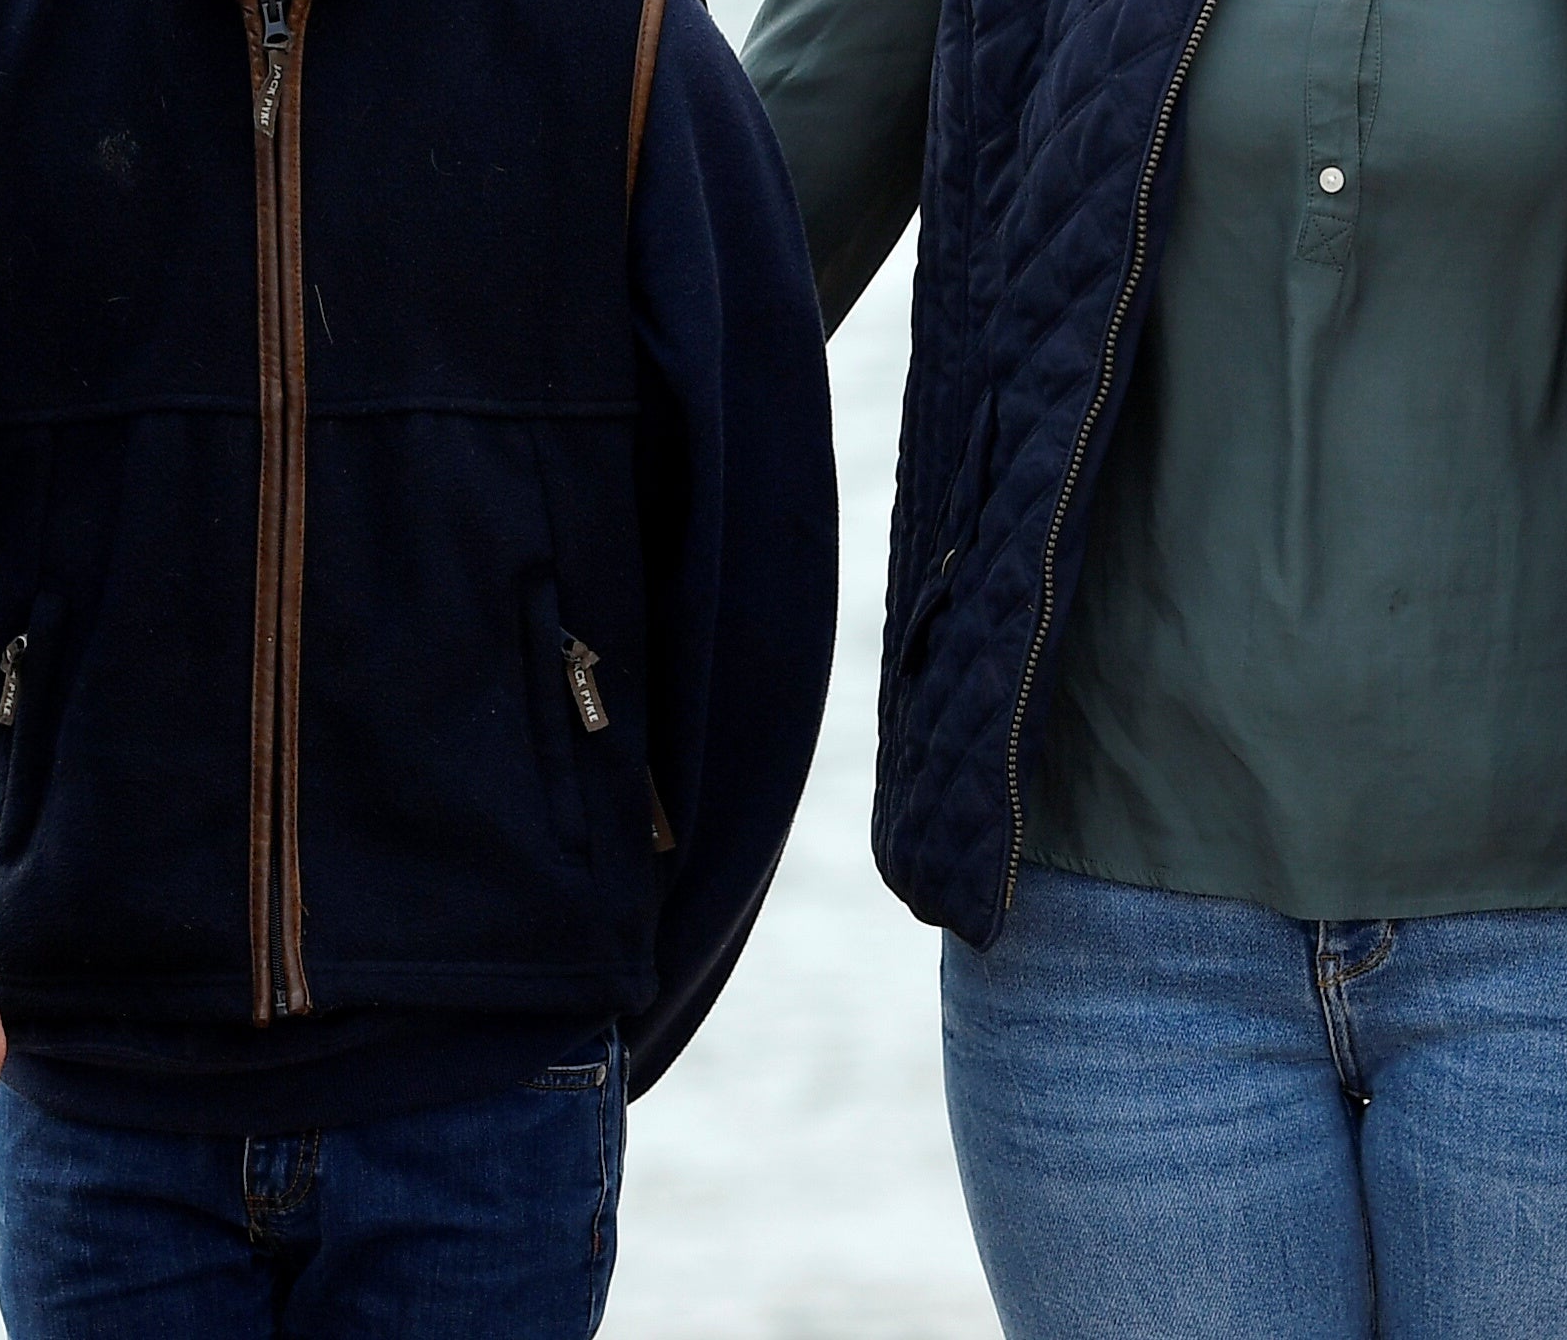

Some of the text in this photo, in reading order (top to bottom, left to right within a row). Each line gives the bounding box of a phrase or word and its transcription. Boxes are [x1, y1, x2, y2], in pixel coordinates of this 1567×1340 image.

[260, 63, 282, 127] JACK PYKE
[579, 689, 600, 723] PYKE
